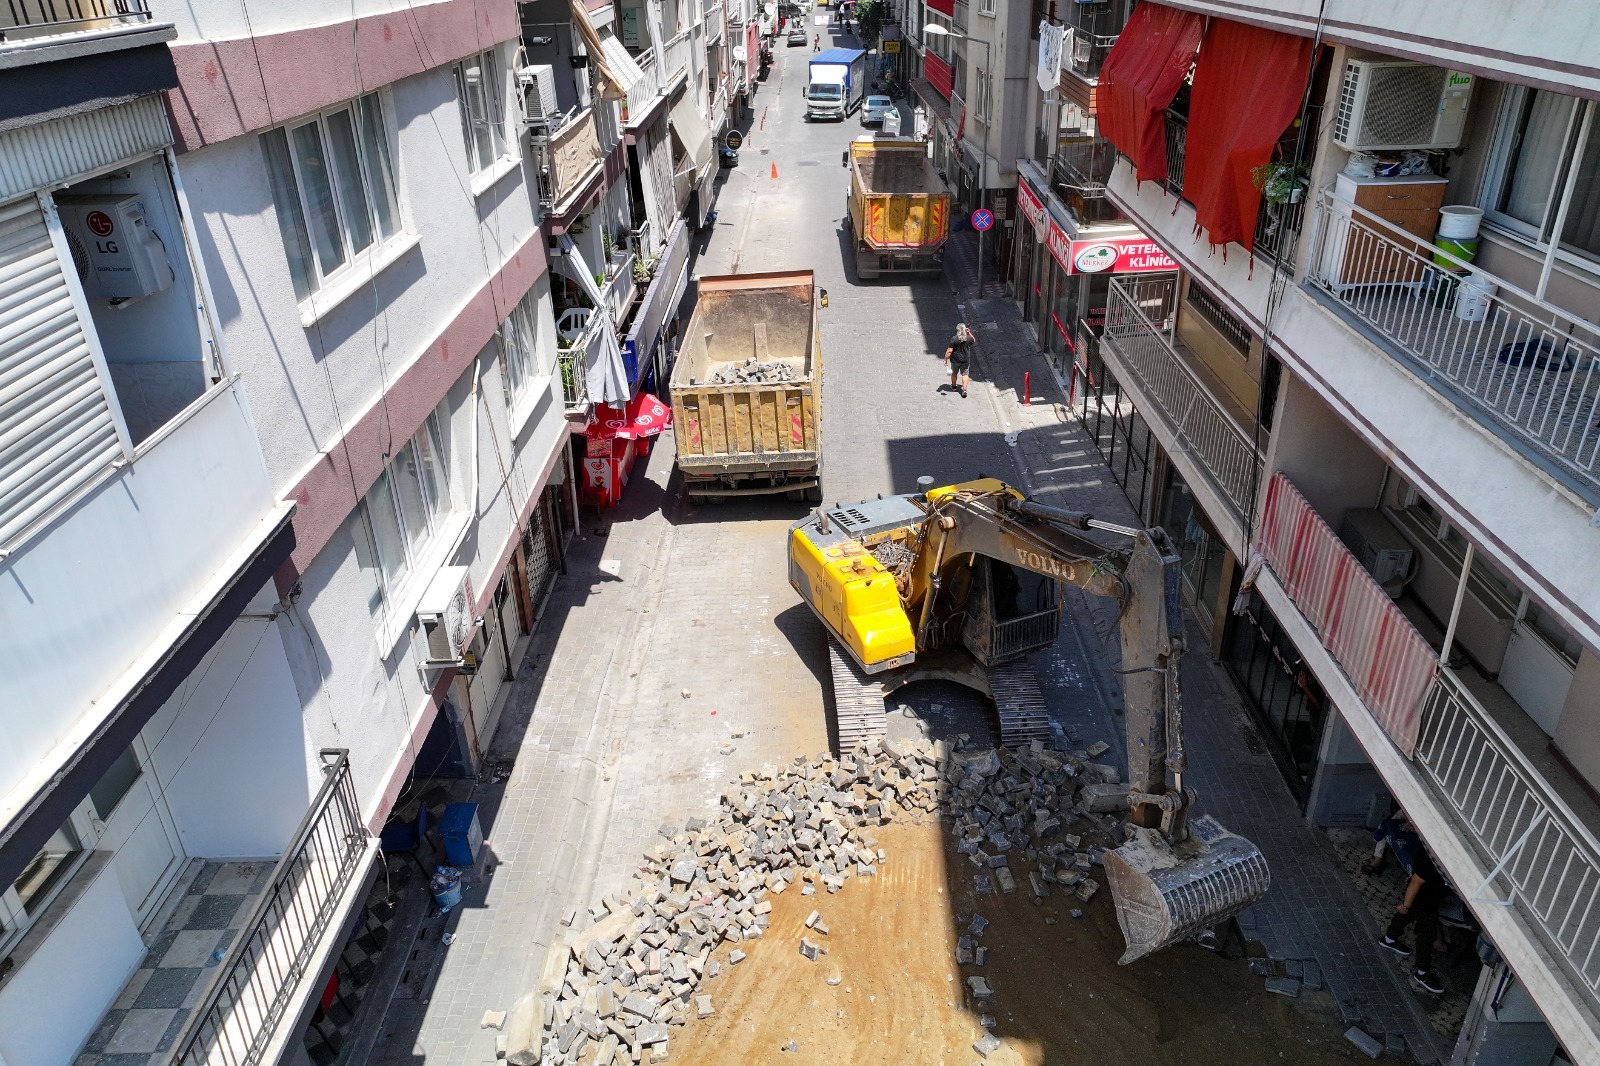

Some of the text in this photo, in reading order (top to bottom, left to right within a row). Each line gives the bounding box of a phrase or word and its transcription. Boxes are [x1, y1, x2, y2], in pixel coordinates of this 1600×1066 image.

[96, 241, 119, 253] LG
[1119, 243, 1165, 255] VETER
[1015, 547, 1076, 580] VOLVO
